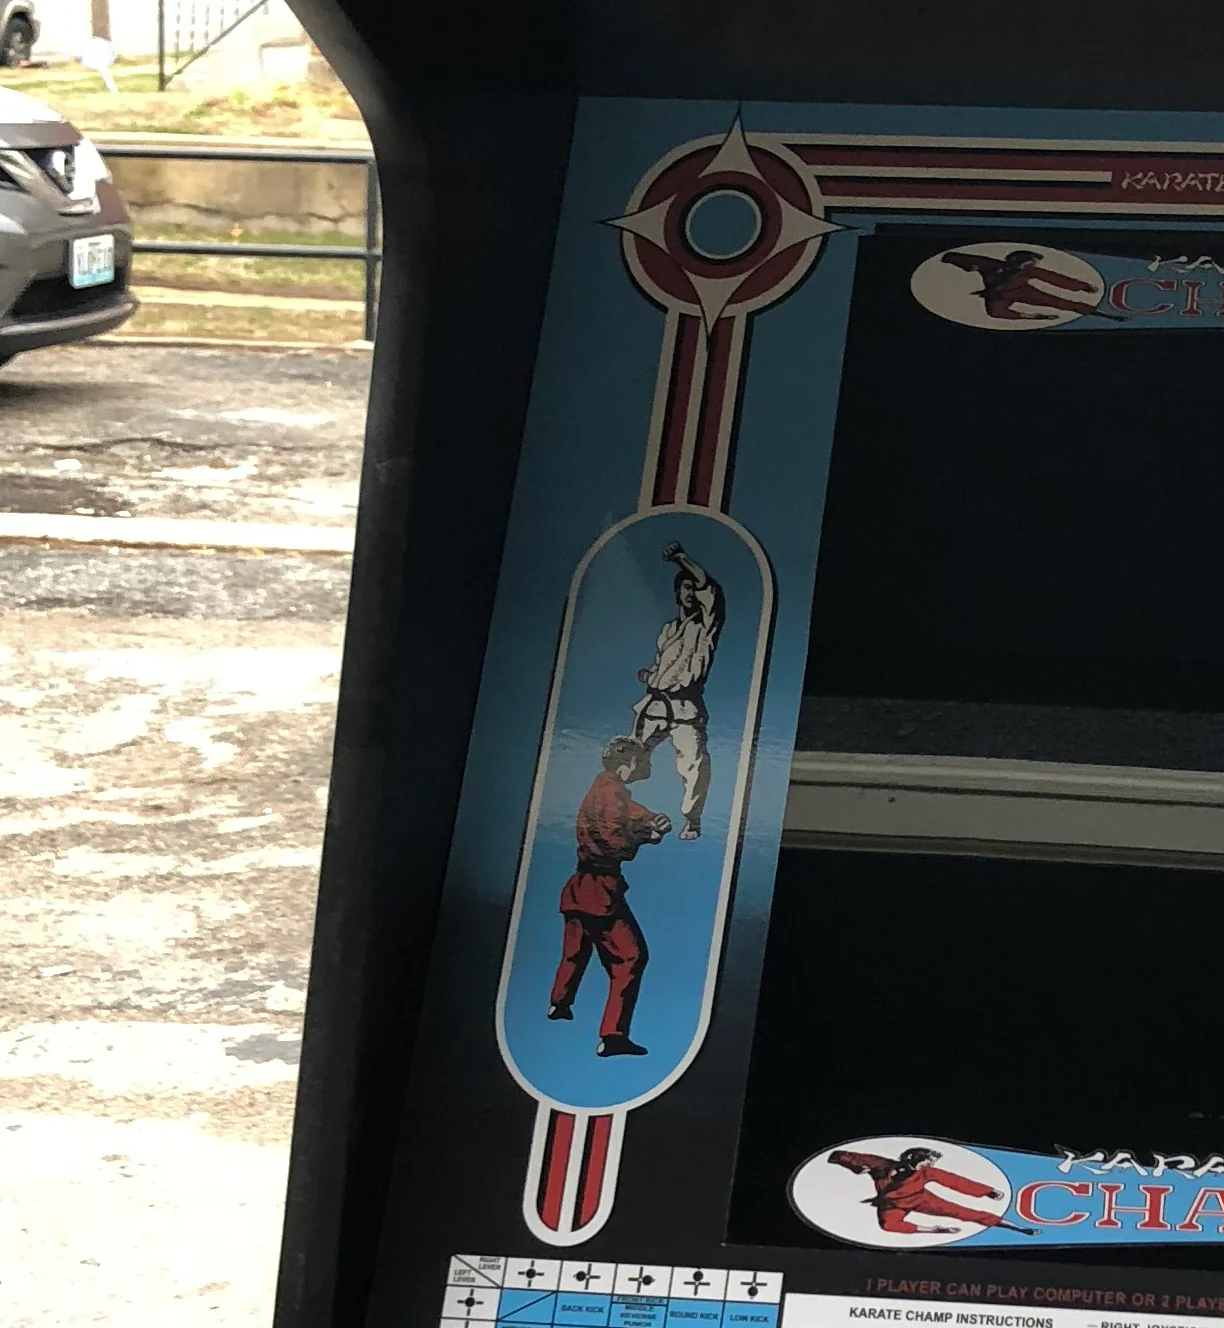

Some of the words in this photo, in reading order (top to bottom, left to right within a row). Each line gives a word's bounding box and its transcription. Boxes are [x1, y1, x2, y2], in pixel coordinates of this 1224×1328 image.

[878, 1279, 941, 1295] PLAYER
[946, 1283, 981, 1297] CAN
[986, 1285, 1029, 1300] PLAY
[1032, 1287, 1126, 1304] COMPUTER
[1130, 1293, 1156, 1308] OR
[1160, 1296, 1169, 1308] 2
[849, 1307, 902, 1321] KARATE
[905, 1310, 954, 1323] CHAMP
